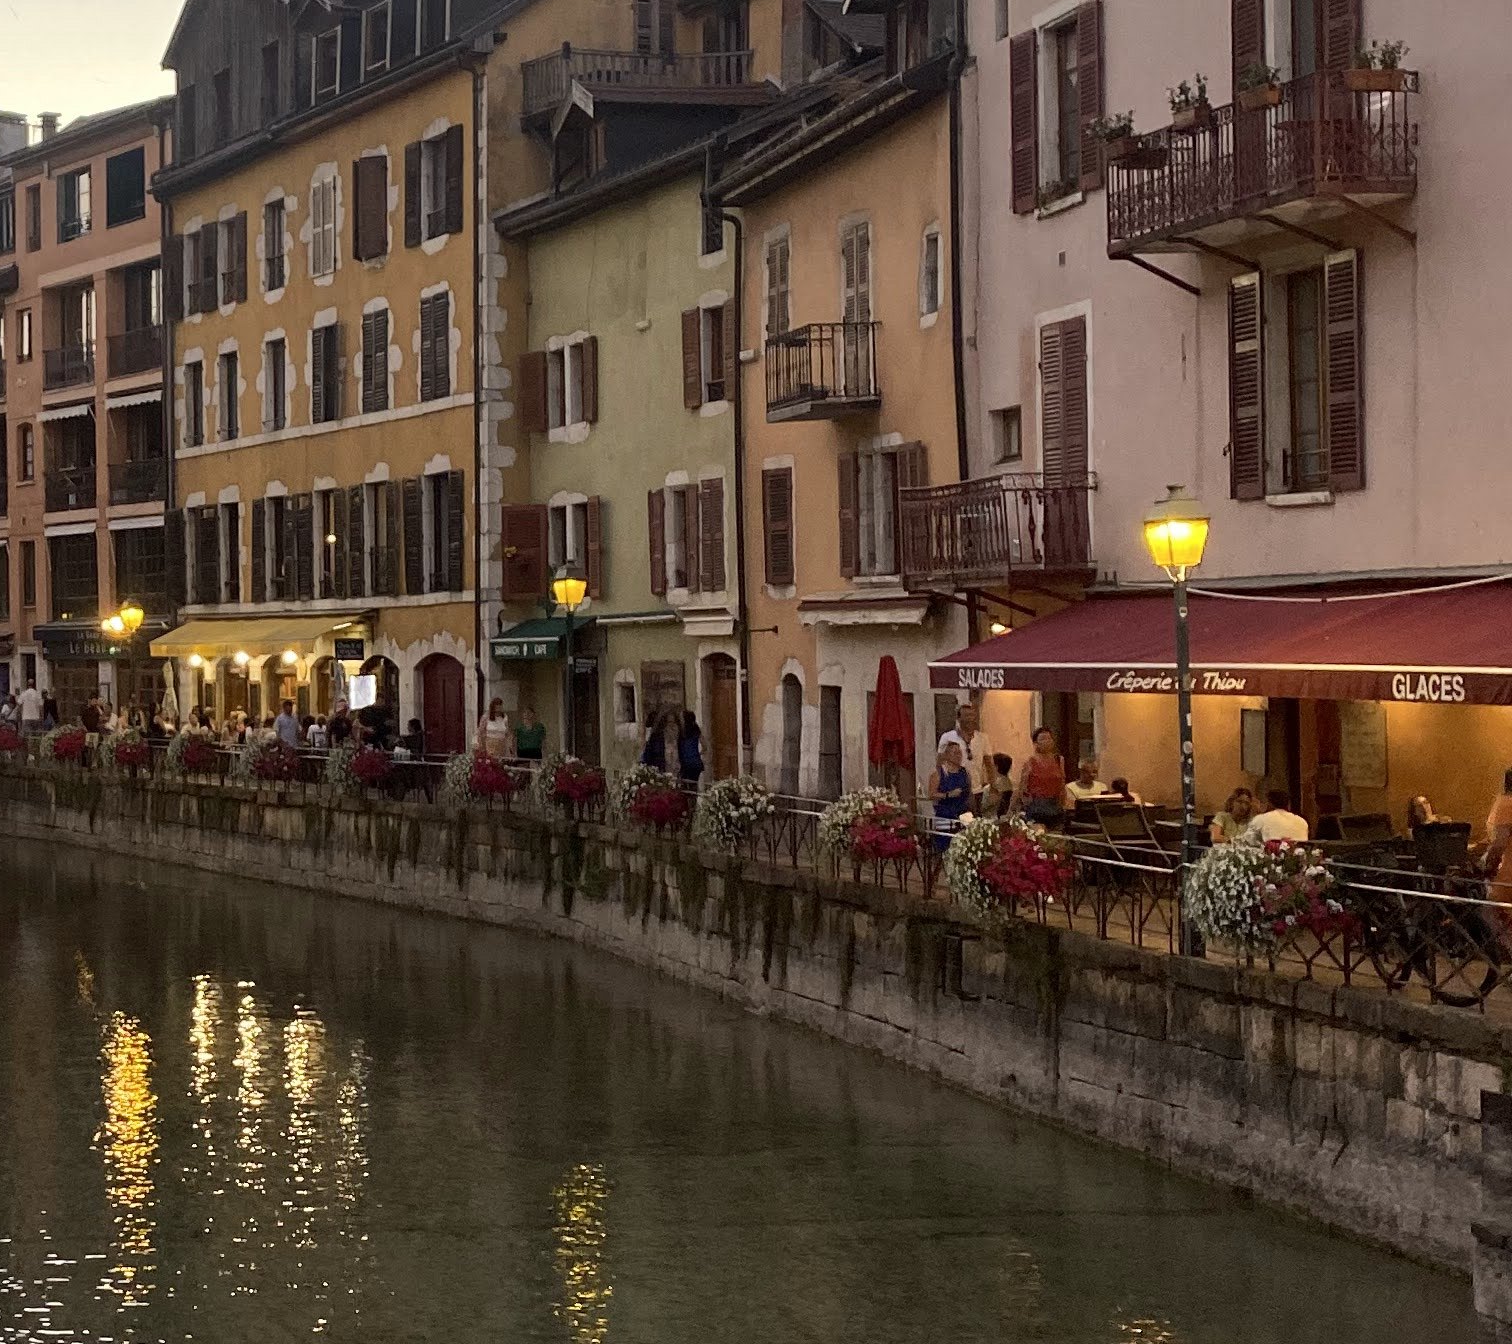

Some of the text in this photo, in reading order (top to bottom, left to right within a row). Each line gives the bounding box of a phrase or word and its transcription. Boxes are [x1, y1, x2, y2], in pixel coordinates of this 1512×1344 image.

[958, 668, 1005, 690] SALADES
[1106, 670, 1173, 693] Crêperie
[1203, 670, 1247, 691] Thiou
[1392, 673, 1466, 702] GLACES
